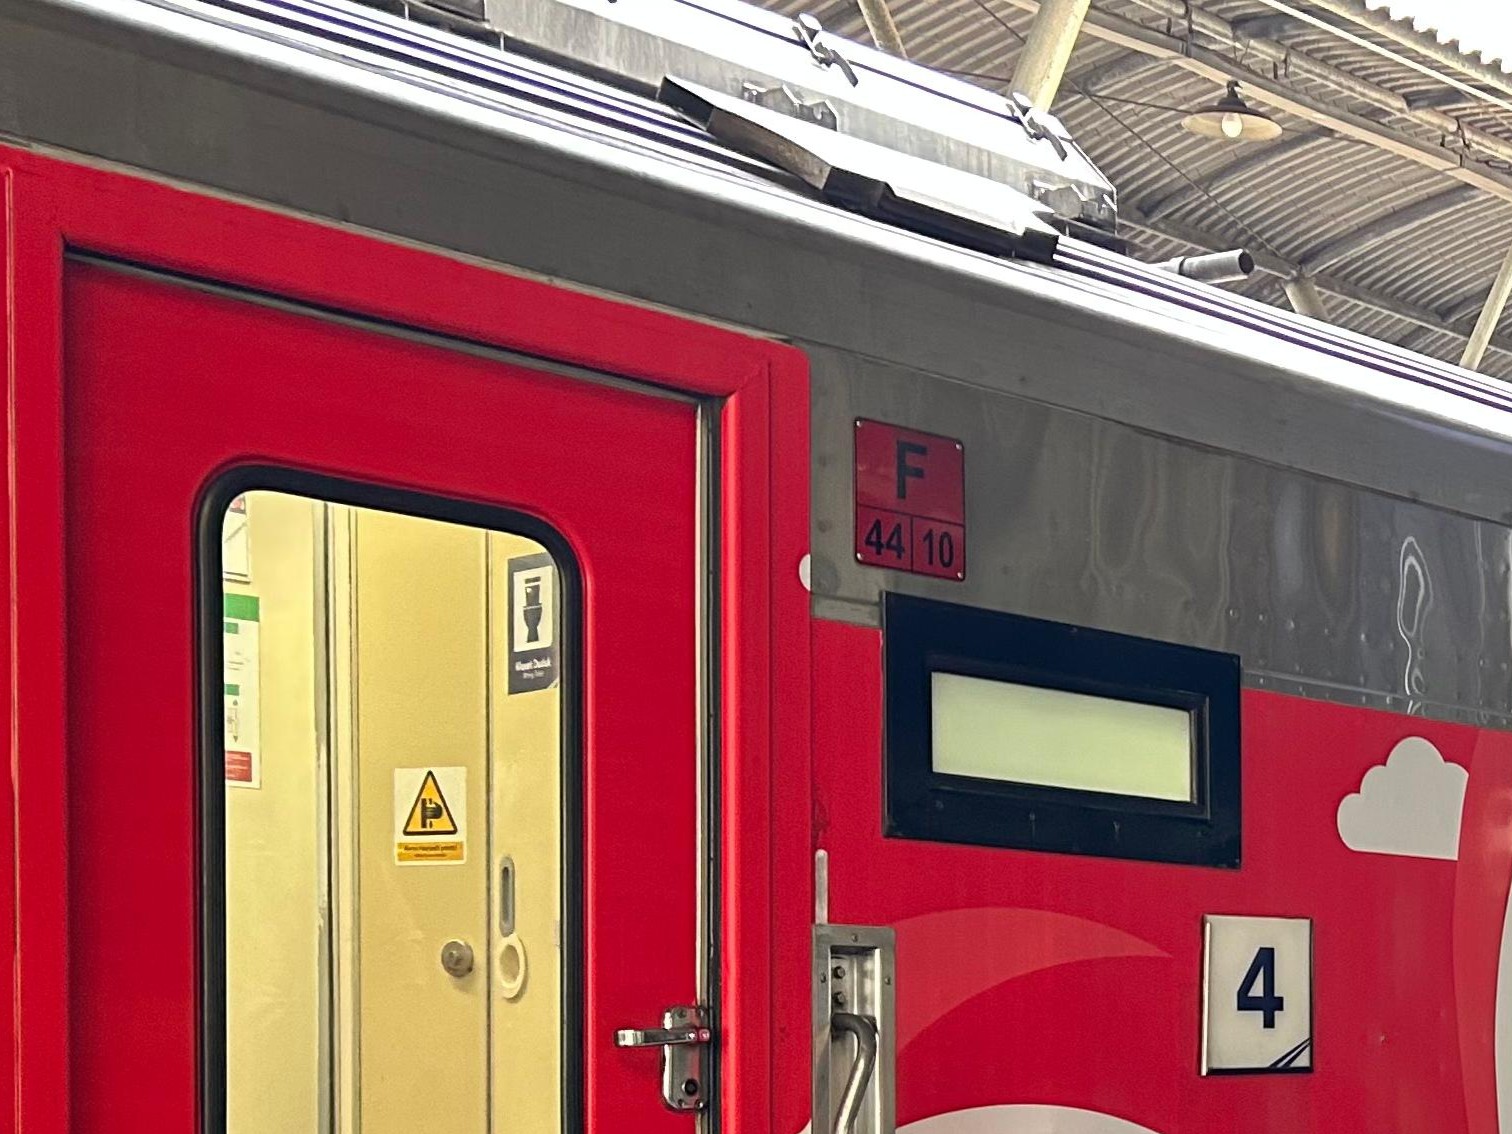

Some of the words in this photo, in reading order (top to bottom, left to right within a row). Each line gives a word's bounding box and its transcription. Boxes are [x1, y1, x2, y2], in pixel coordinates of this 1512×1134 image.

[896, 440, 927, 499] F
[864, 519, 905, 559] 44
[923, 528, 954, 568] 10
[1237, 947, 1284, 1028] 4
